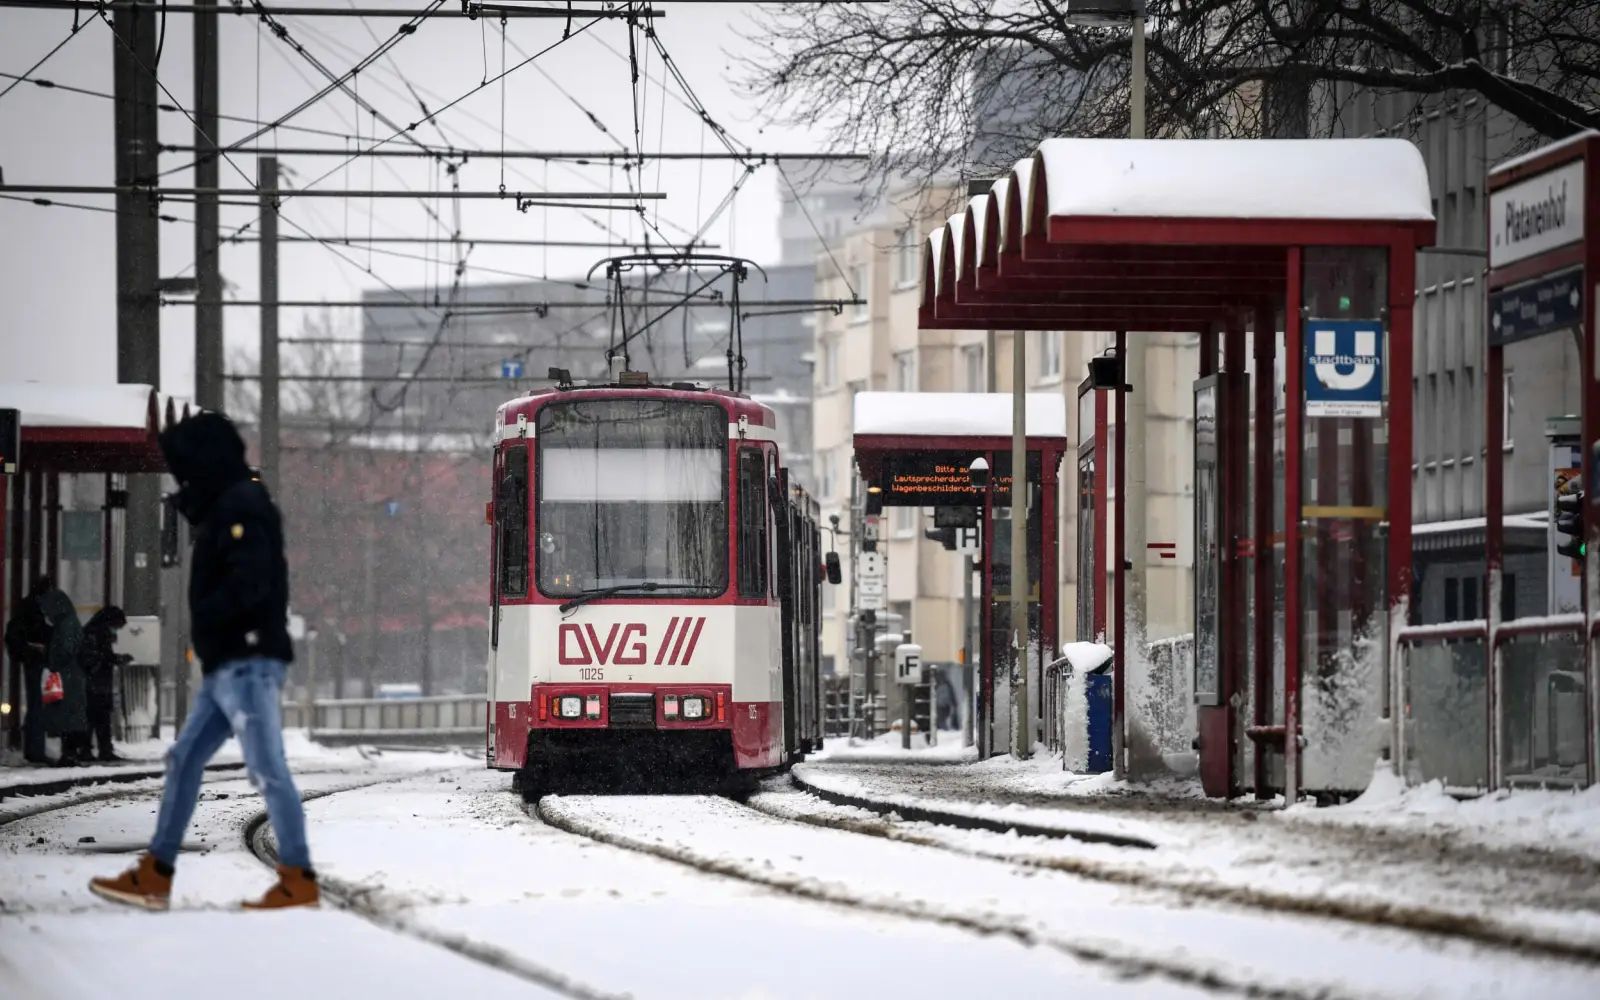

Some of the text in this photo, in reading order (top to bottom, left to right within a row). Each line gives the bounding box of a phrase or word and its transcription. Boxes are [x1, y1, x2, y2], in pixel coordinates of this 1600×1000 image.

[1505, 178, 1567, 246] Platanenhof
[1308, 354, 1380, 366] stadtbahn
[1314, 330, 1376, 390] U
[935, 465, 956, 473] Bitte
[891, 484, 977, 494] Wagenbeschilderung
[961, 526, 980, 548] H
[558, 623, 647, 666] DVG
[579, 668, 604, 681] 1025
